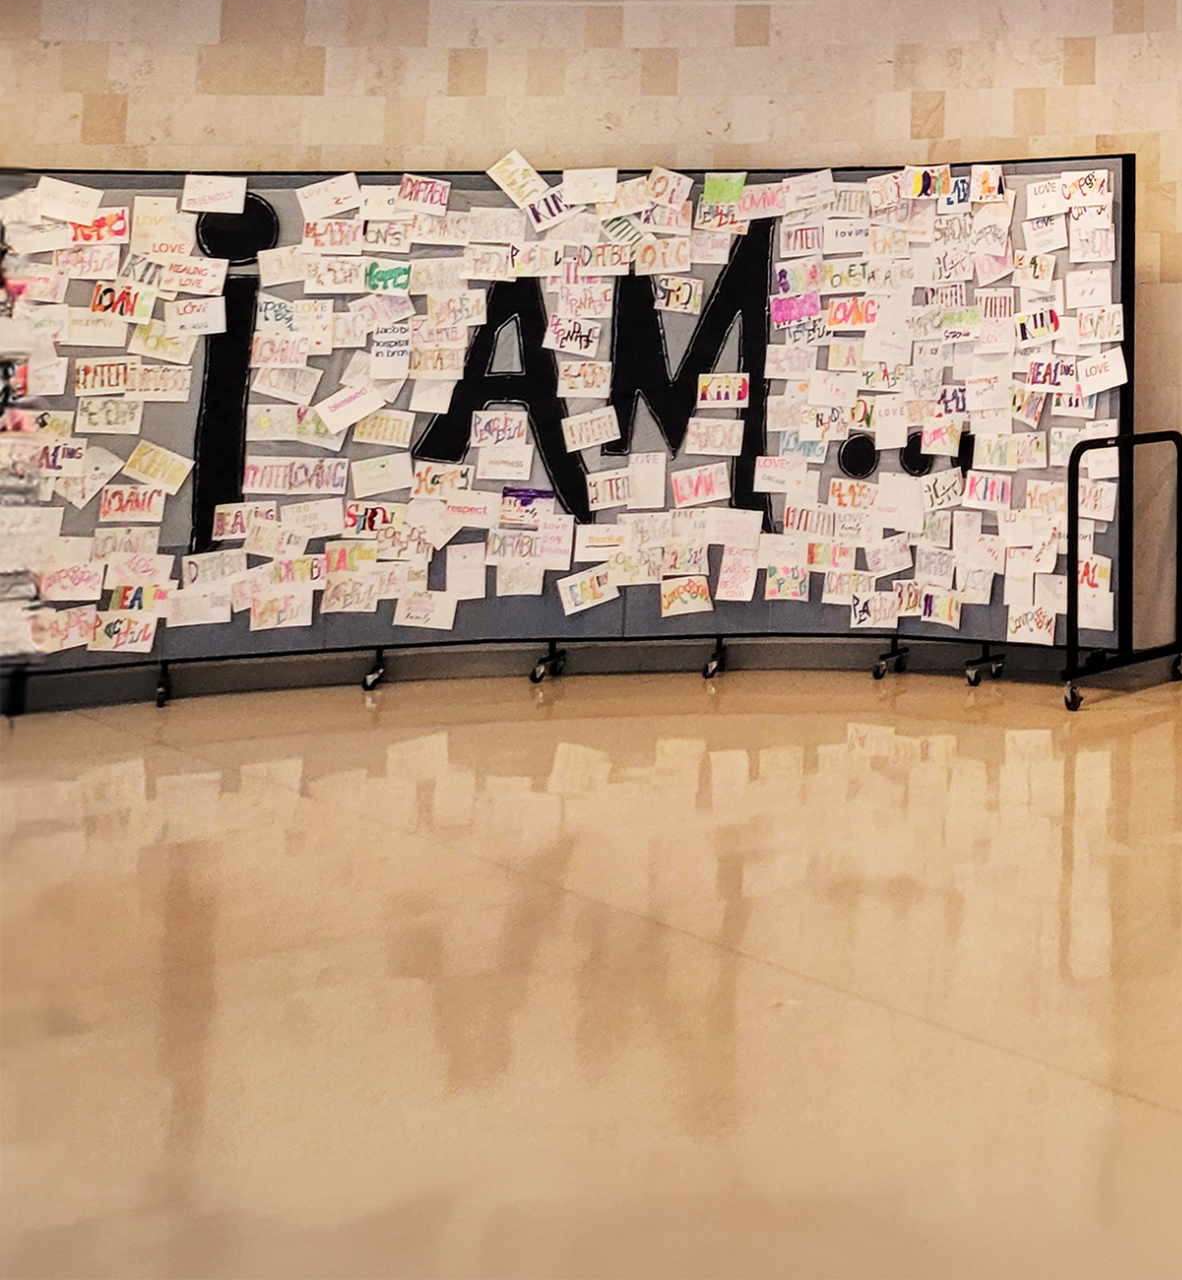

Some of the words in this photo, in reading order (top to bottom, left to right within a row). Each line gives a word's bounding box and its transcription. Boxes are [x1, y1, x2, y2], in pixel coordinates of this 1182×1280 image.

[1034, 181, 1057, 196] LOVE
[1033, 218, 1056, 232] LOVE
[834, 228, 870, 242] loving
[152, 242, 186, 257] LOVE
[829, 298, 877, 326] LOVING
[1018, 309, 1061, 342] KIND
[1086, 362, 1110, 379] LOVE
[879, 406, 906, 418] LOVE
[758, 457, 788, 471] LOVE
[447, 503, 488, 518] respect
